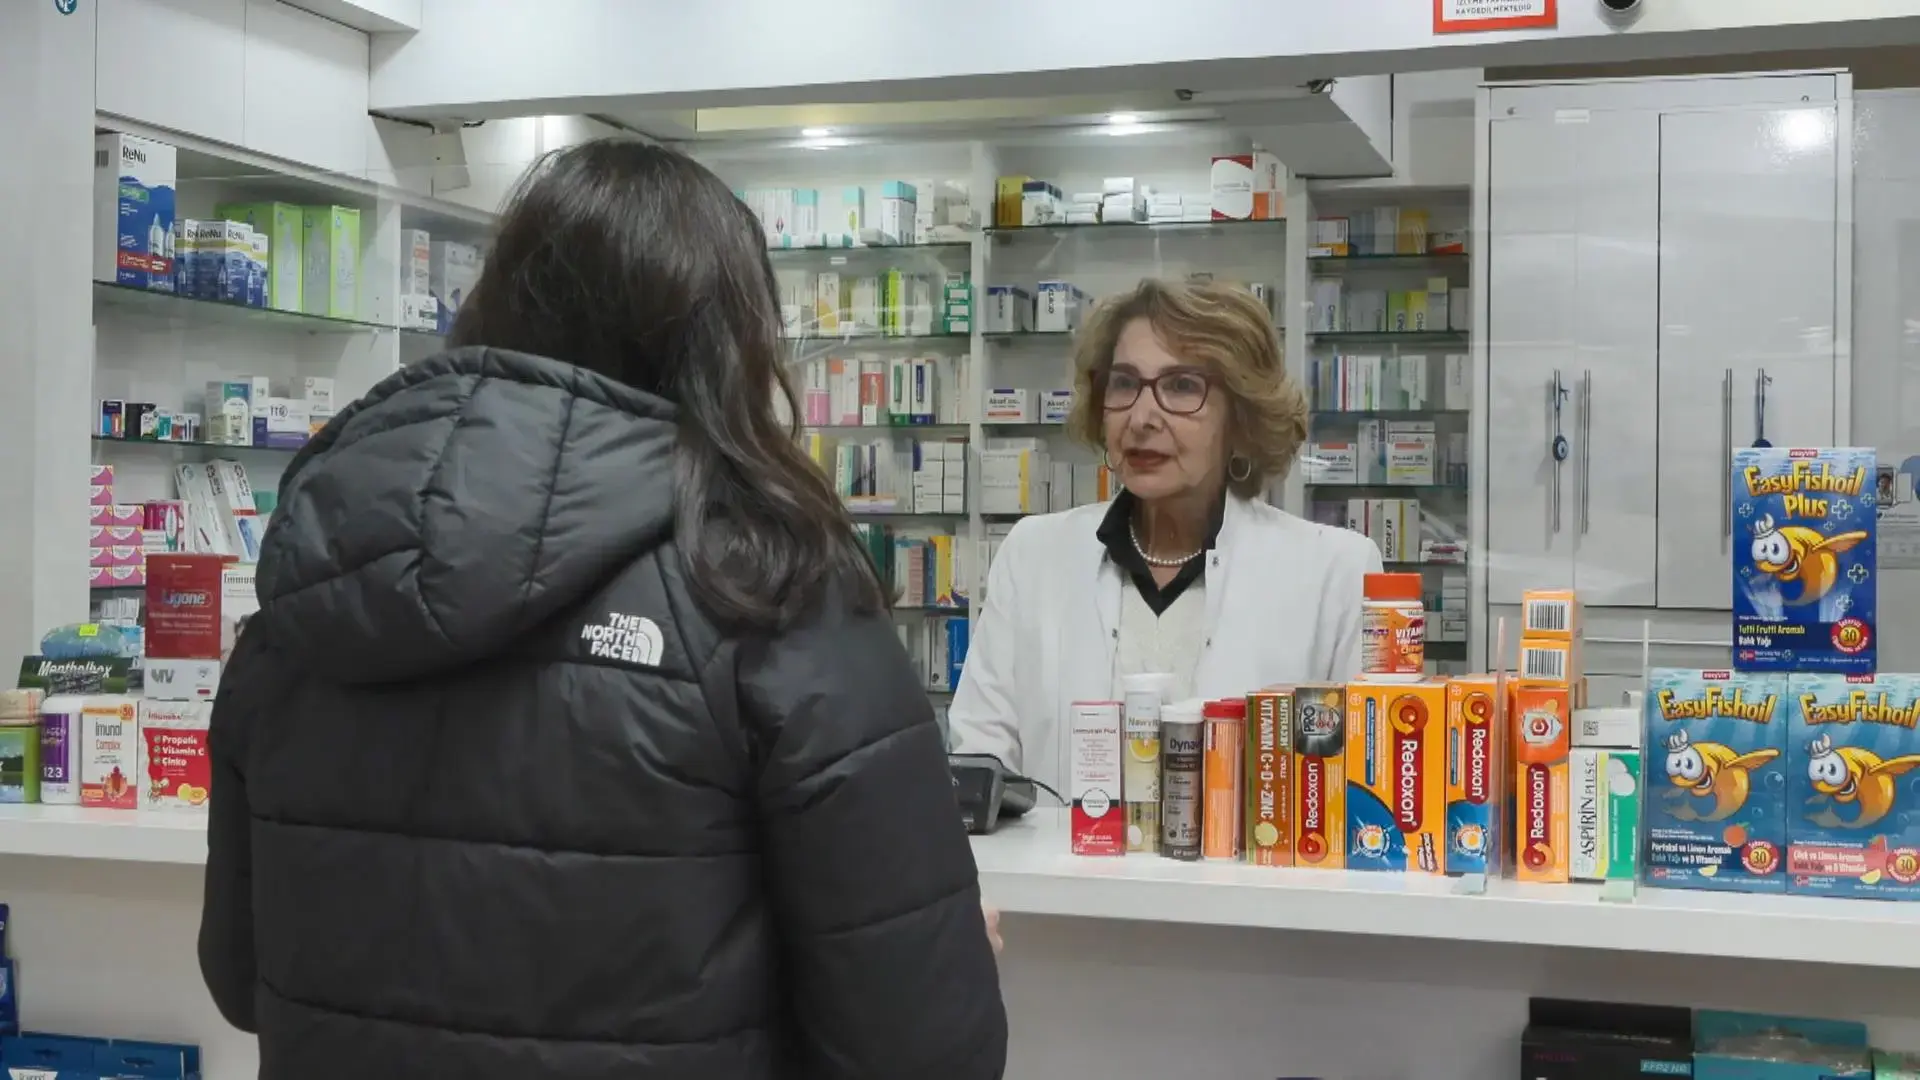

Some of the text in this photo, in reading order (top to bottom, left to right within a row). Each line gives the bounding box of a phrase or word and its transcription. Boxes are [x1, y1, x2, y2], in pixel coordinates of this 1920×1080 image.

[122, 145, 146, 163] ReNu
[1743, 461, 1867, 497] EasyFishoil
[1782, 493, 1829, 519] Plus
[609, 612, 640, 631] THE
[580, 624, 637, 647] NORTH
[1843, 628, 1858, 643] 30
[590, 641, 632, 661] FACE
[1303, 705, 1316, 732] PRO
[1657, 687, 1778, 725] EasyFishoil
[1260, 698, 1274, 750] VITAMIN
[162, 746, 196, 756] Vitamin
[1471, 728, 1486, 797] Redoxon
[1400, 739, 1418, 824] Redoxon
[1305, 762, 1318, 829] Redoxon
[1531, 769, 1545, 839] Redoxon
[1752, 851, 1767, 864] 30
